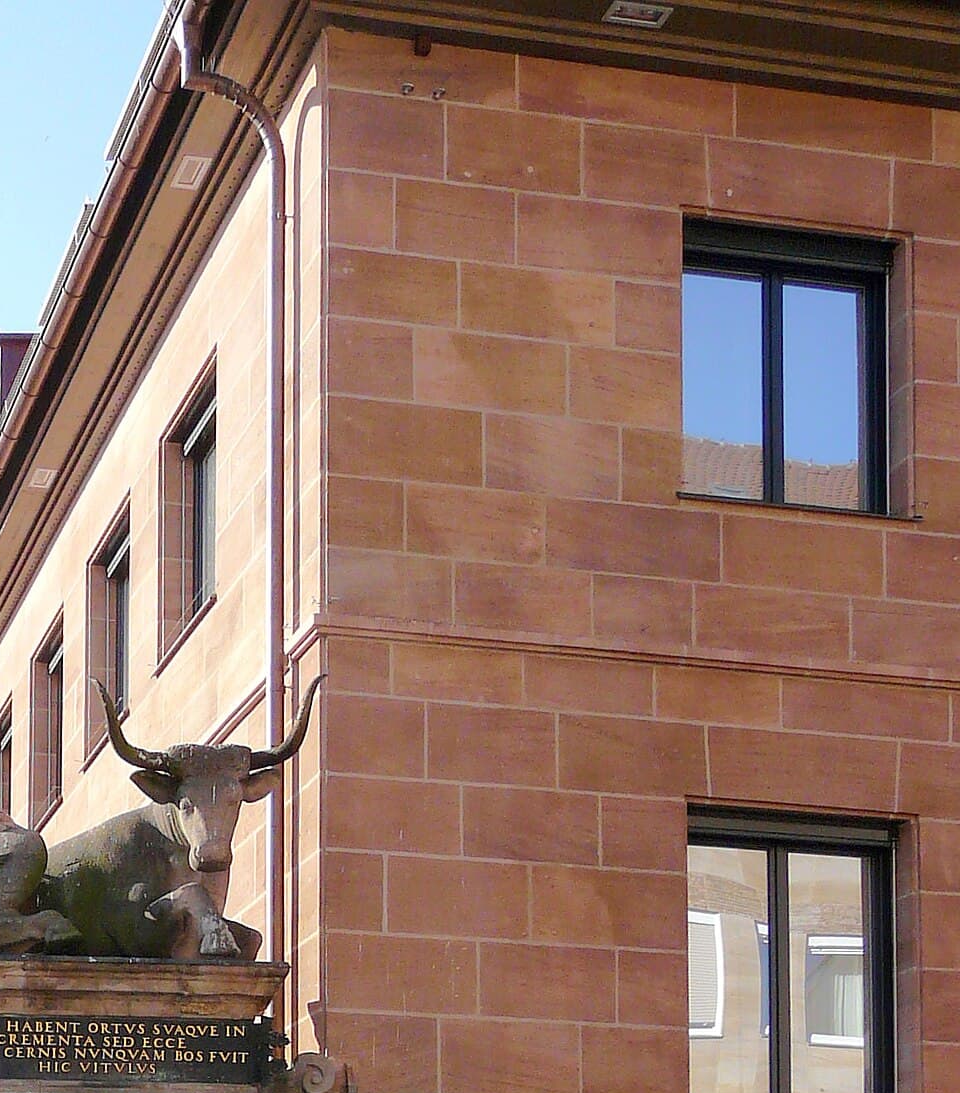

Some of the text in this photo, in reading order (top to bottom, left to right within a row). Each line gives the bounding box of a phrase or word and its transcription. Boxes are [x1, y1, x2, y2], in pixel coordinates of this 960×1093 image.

[7, 1020, 81, 1033] HABENT
[88, 1022, 146, 1035] ORTVS
[152, 1024, 220, 1037] SVAQVE
[225, 1025, 246, 1037] IN
[102, 1036, 135, 1048] SED
[142, 1036, 187, 1049] ECCE
[4, 1046, 67, 1059] CERNIS
[74, 1048, 166, 1062] NVNQVAM
[175, 1050, 204, 1063] BOS
[209, 1051, 249, 1064] FVIT
[39, 1061, 157, 1074] HIC VITVLVS
